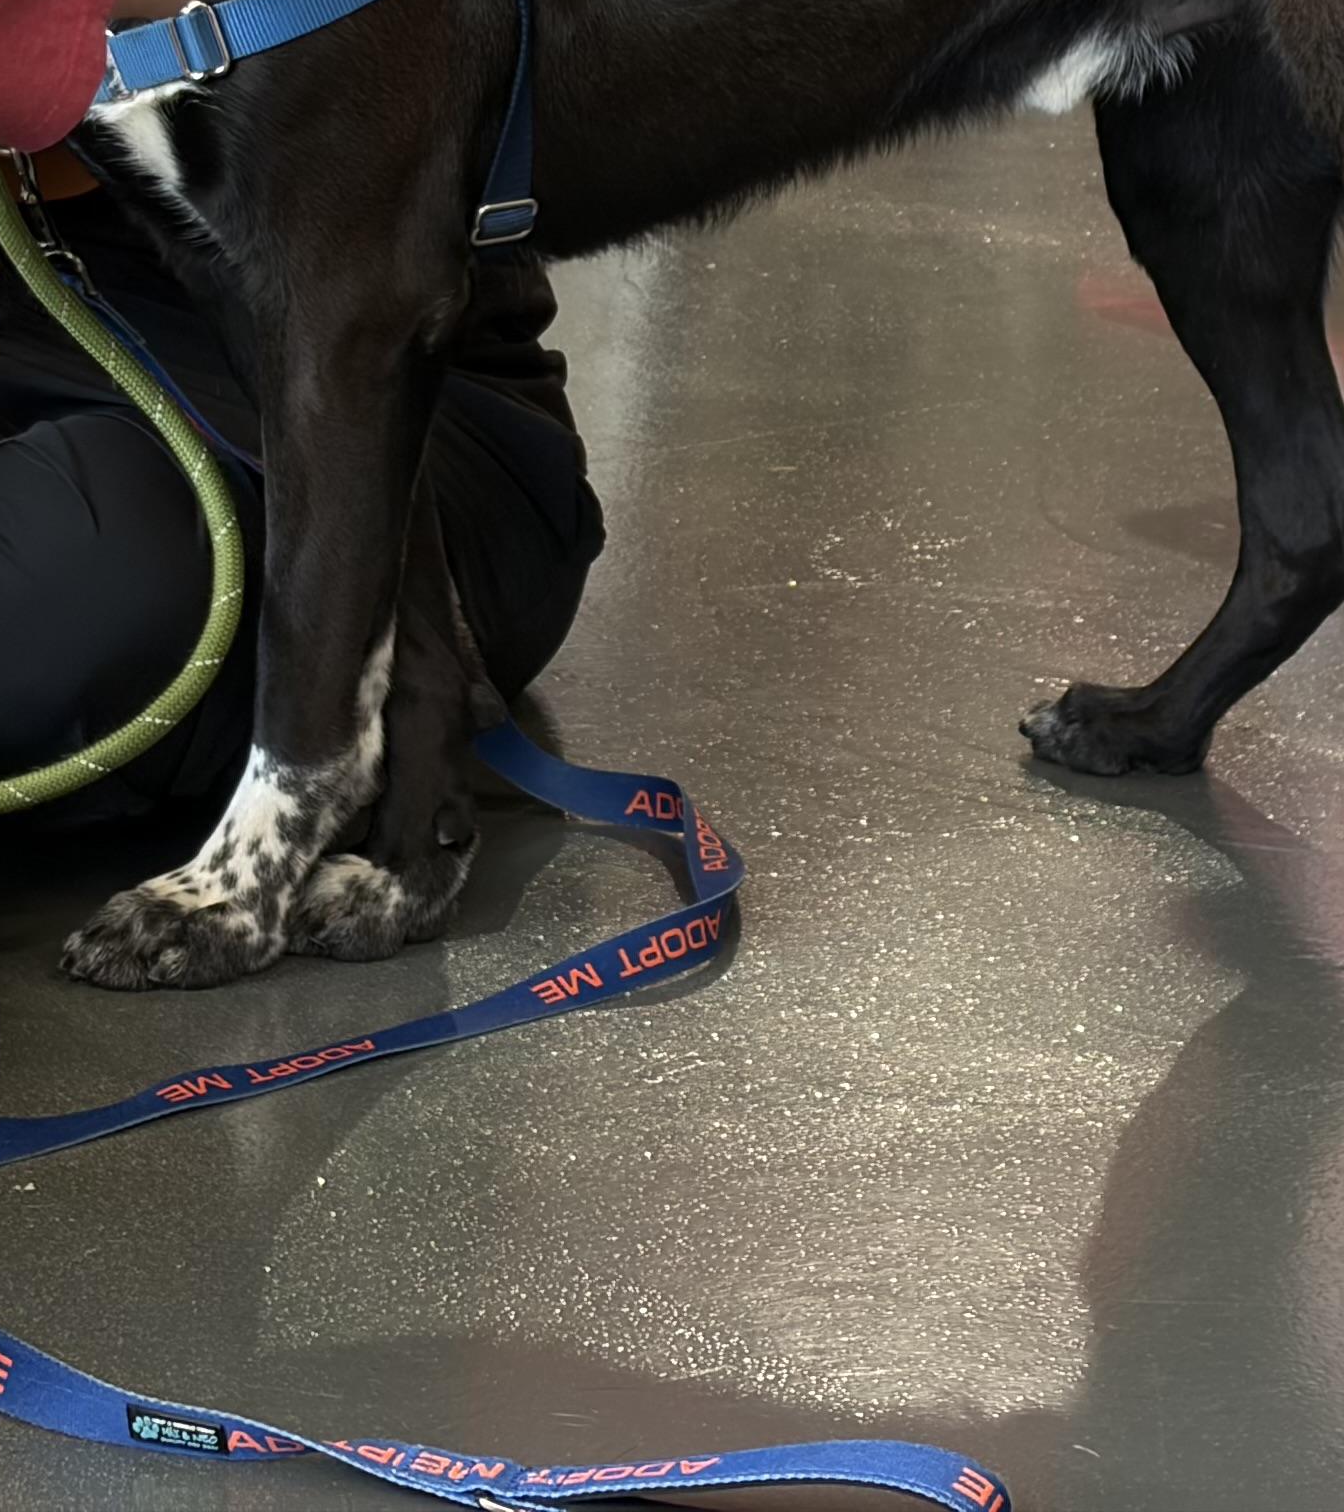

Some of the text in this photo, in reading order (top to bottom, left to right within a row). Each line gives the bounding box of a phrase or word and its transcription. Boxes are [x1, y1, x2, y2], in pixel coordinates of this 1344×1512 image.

[529, 907, 722, 1007] ADOPT ME
[153, 1038, 376, 1104] ADOPT ME
